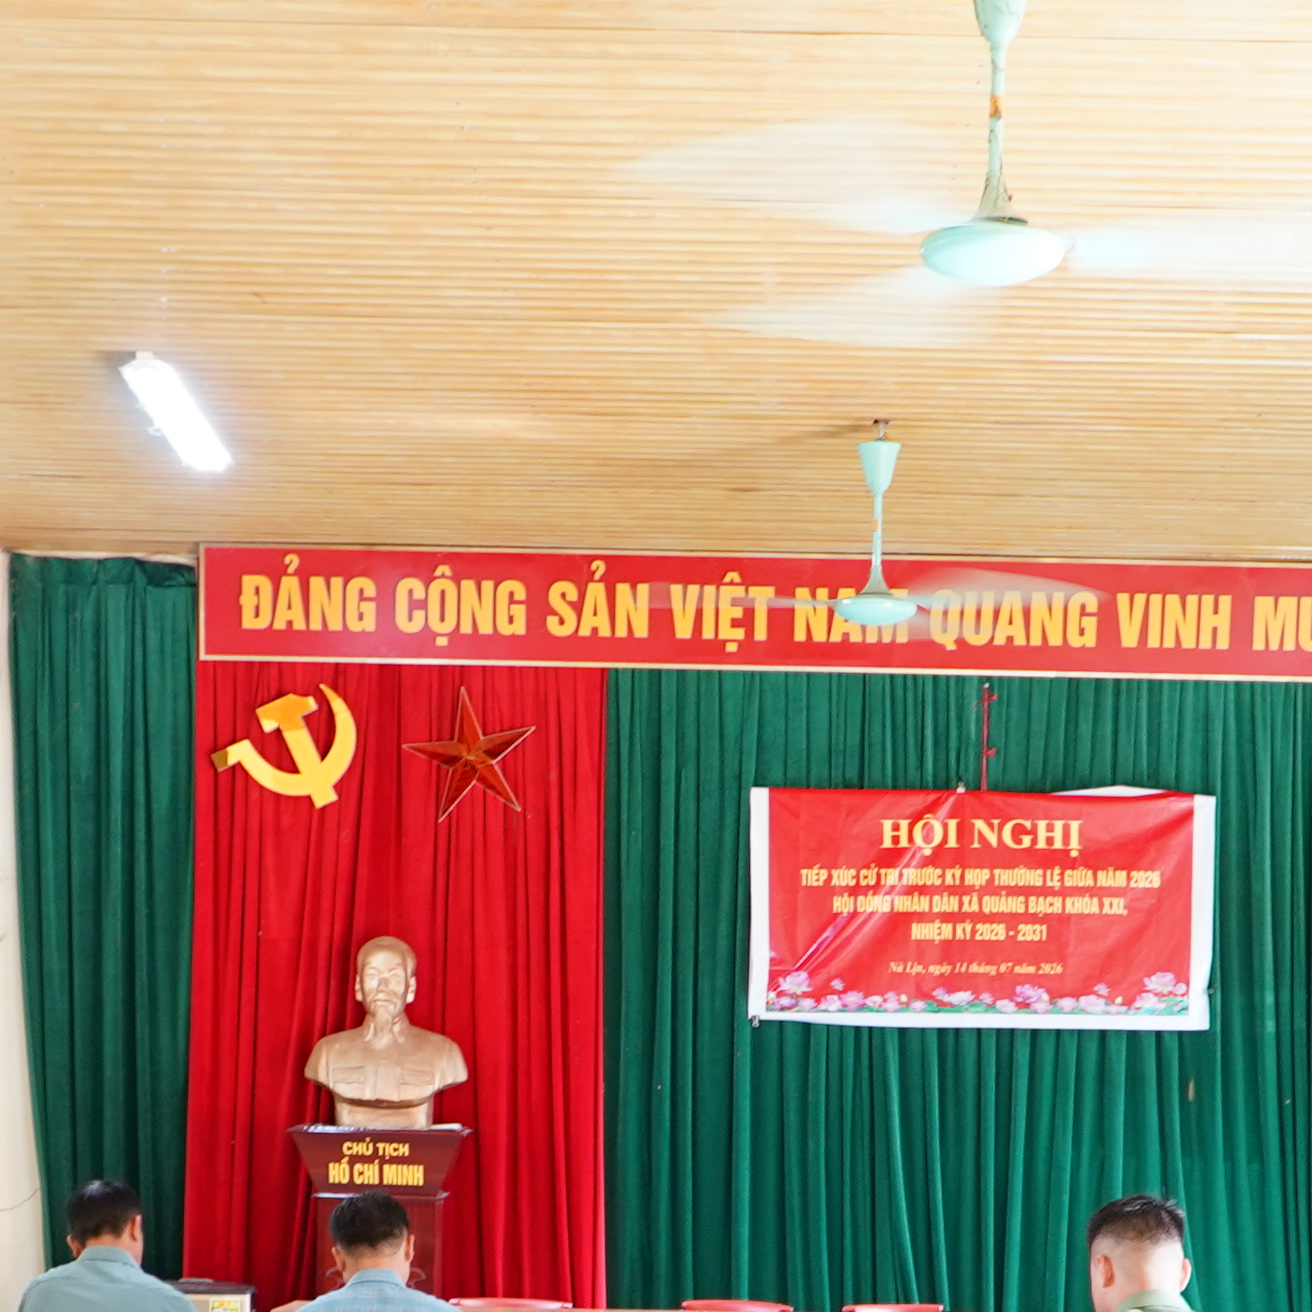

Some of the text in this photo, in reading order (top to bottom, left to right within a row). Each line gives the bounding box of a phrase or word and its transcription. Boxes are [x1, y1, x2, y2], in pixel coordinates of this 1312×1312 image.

[240, 553, 377, 632] ĐẢNG
[395, 565, 527, 647] CỘNG
[546, 559, 650, 640] SẢN
[670, 571, 775, 653] VIỆT
[929, 588, 1098, 650] QUANG
[1117, 593, 1232, 650] VINH
[879, 813, 1083, 858] HỘI NGHỊ
[800, 863, 828, 887] TIẾP
[830, 865, 857, 887] XÚC
[859, 863, 879, 887] CỬ
[879, 868, 900, 887] TRI
[901, 865, 943, 887] TRƯỚC
[964, 867, 990, 890] HỌP
[993, 865, 1043, 888] THƯỜNG
[1046, 866, 1062, 891] LỆ
[1063, 866, 1094, 888] GIỮA
[1096, 866, 1127, 888] NĂM
[1129, 869, 1162, 889] 2026
[832, 891, 855, 916] HỘI
[856, 889, 891, 913] ĐỒNG
[893, 891, 930, 913] NHÂN
[932, 891, 959, 913] DÂN
[961, 891, 980, 914] XÃ
[982, 890, 1025, 915] QUẢNG
[1028, 895, 1063, 917] BẠCH
[1065, 892, 1100, 914] KHÓA
[911, 918, 953, 944] NHIỆM
[974, 922, 1006, 941] 2026
[1016, 923, 1048, 942] 2031
[342, 1137, 410, 1160] CHỦ TỊCH
[328, 1156, 424, 1186] HỒ CHÍ MINH
